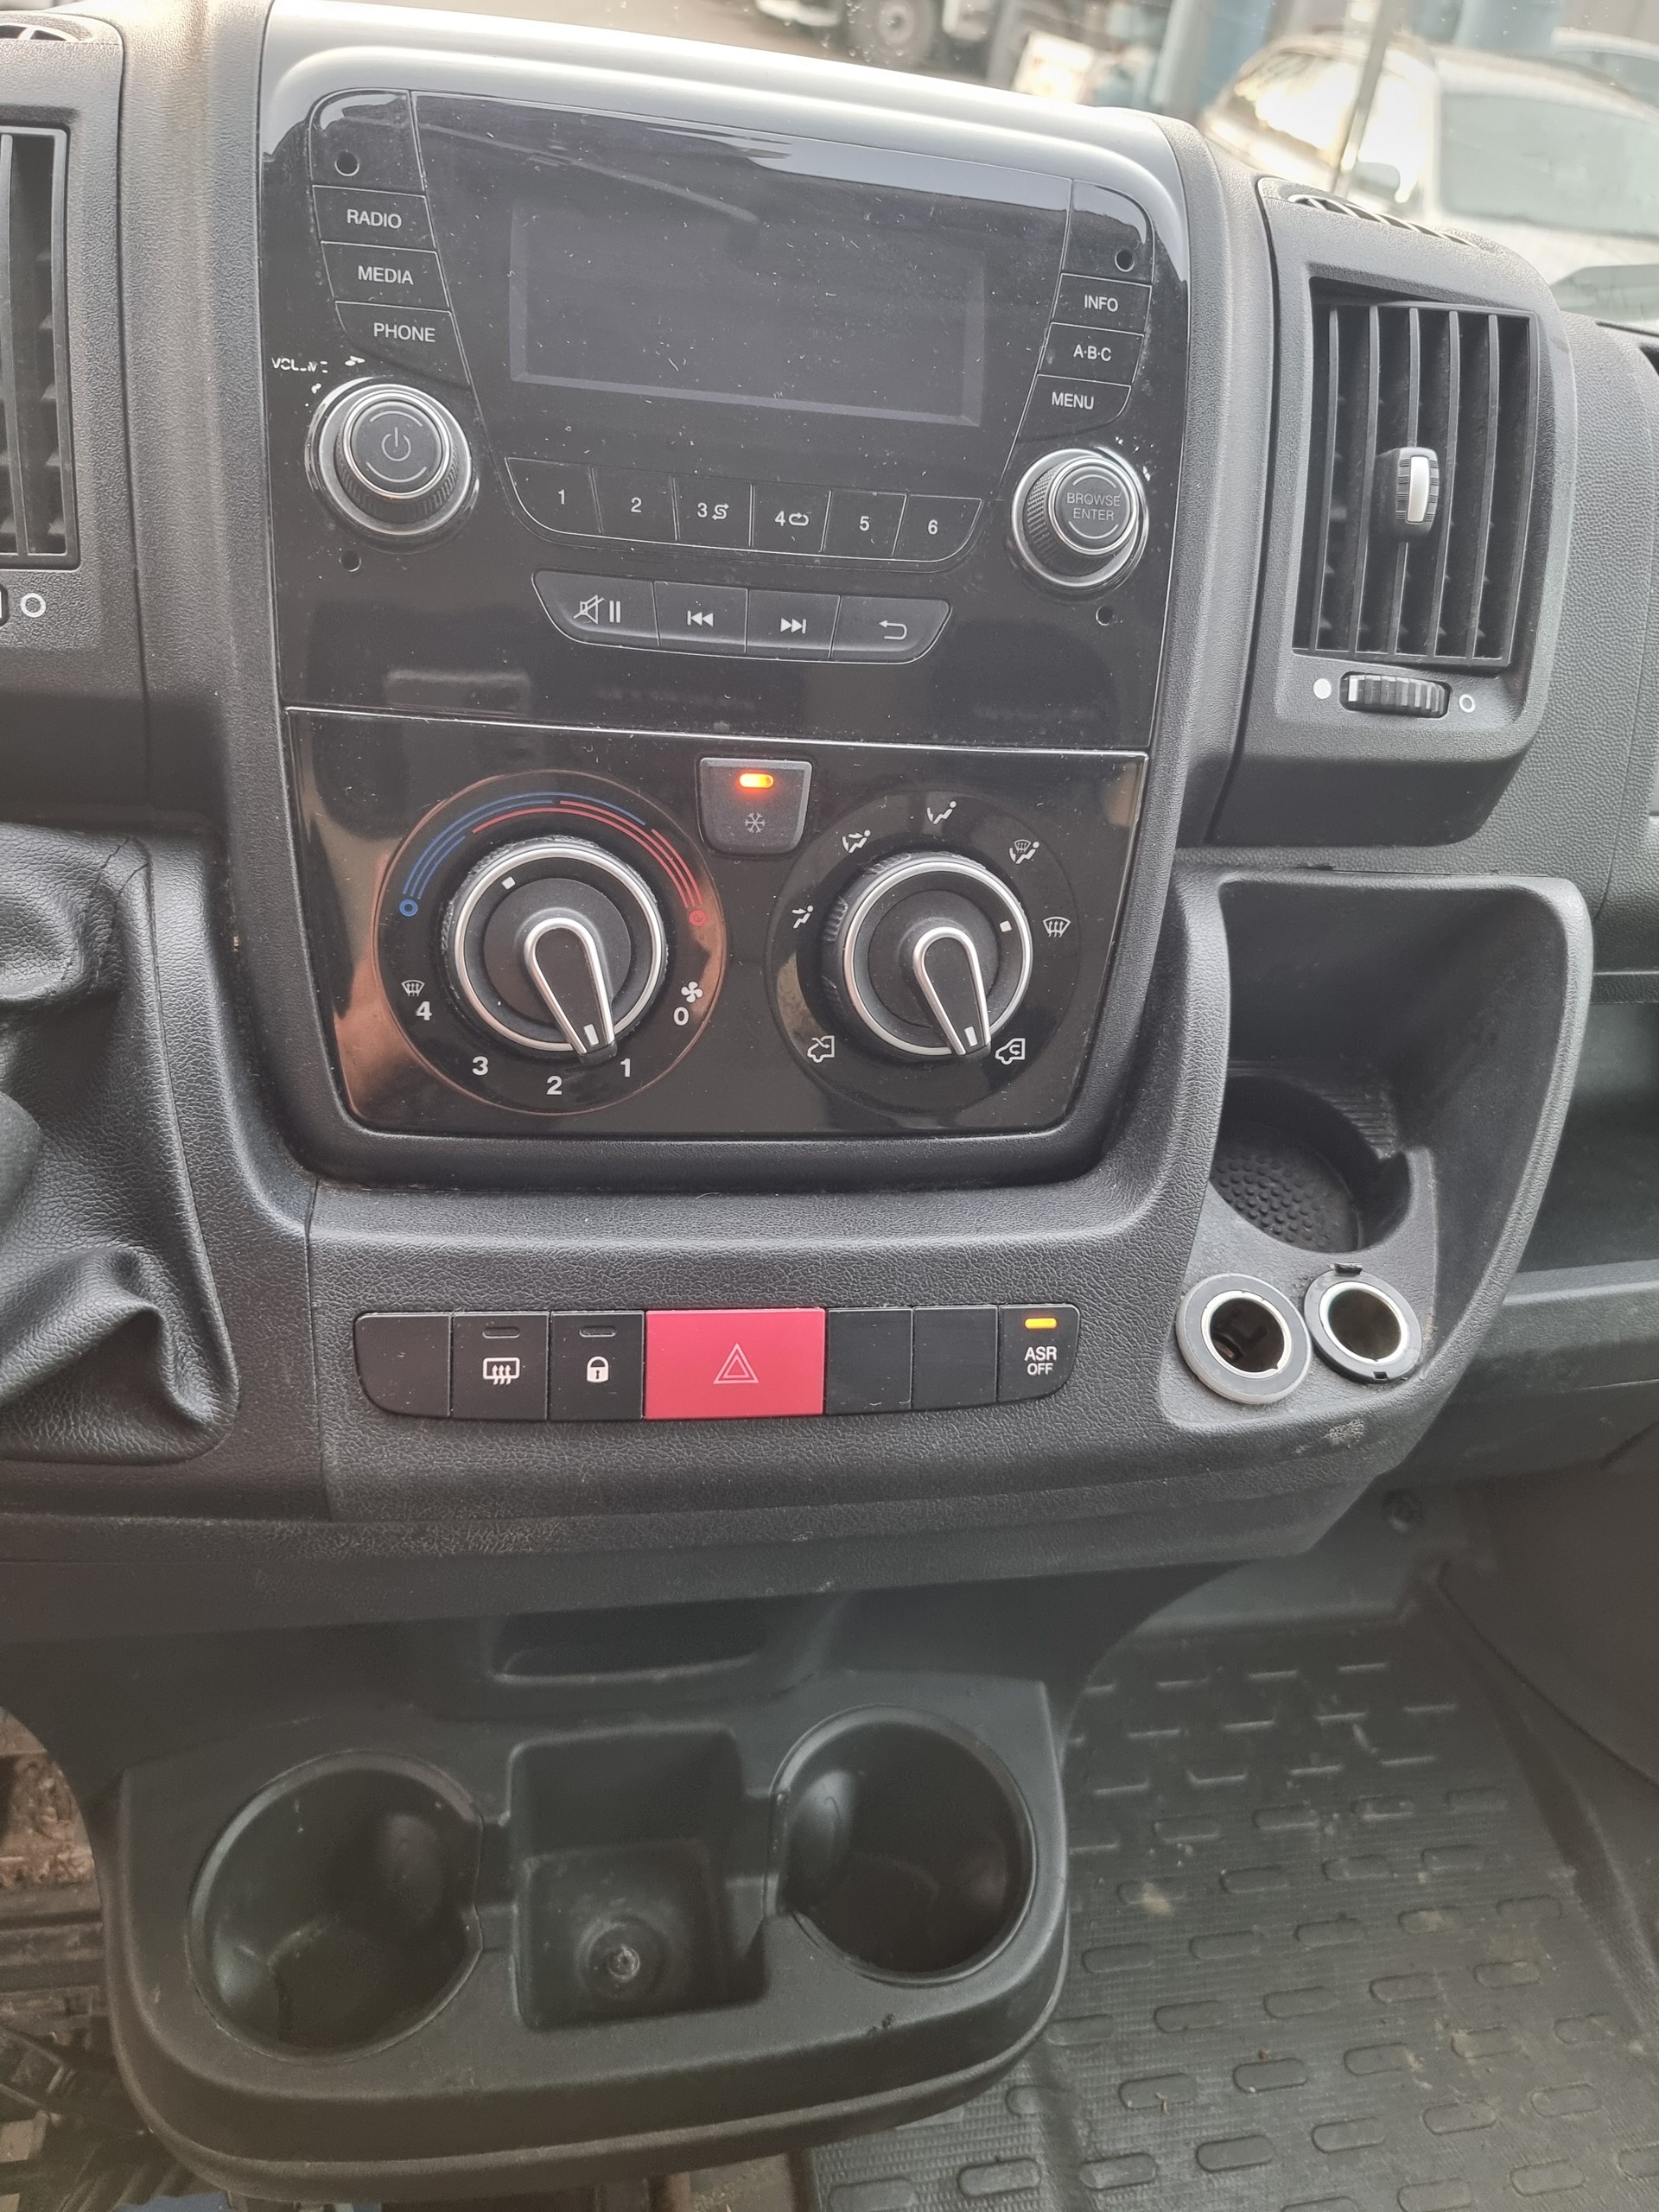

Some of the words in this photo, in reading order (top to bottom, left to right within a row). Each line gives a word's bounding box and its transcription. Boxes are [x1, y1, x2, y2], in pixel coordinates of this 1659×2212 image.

[346, 208, 403, 229] RADIO
[358, 264, 414, 286] MEDIA
[1084, 294, 1119, 313] INFO
[373, 321, 436, 343] PHONE
[1051, 391, 1095, 410] MENU
[557, 488, 565, 505] 1
[630, 497, 642, 513] 2
[1066, 492, 1122, 507] BROWSE
[696, 502, 708, 518] 3
[774, 510, 786, 527] 4
[1073, 507, 1115, 521] ENTER
[859, 515, 870, 531] 5
[927, 518, 938, 535] 6
[416, 1001, 433, 1021] 4
[673, 1007, 690, 1026] 0
[472, 1056, 489, 1076] 3
[620, 1058, 631, 1077] 1
[546, 1075, 563, 1096] 2
[1024, 1344, 1058, 1362] ASR
[1027, 1361, 1054, 1376] OFF
